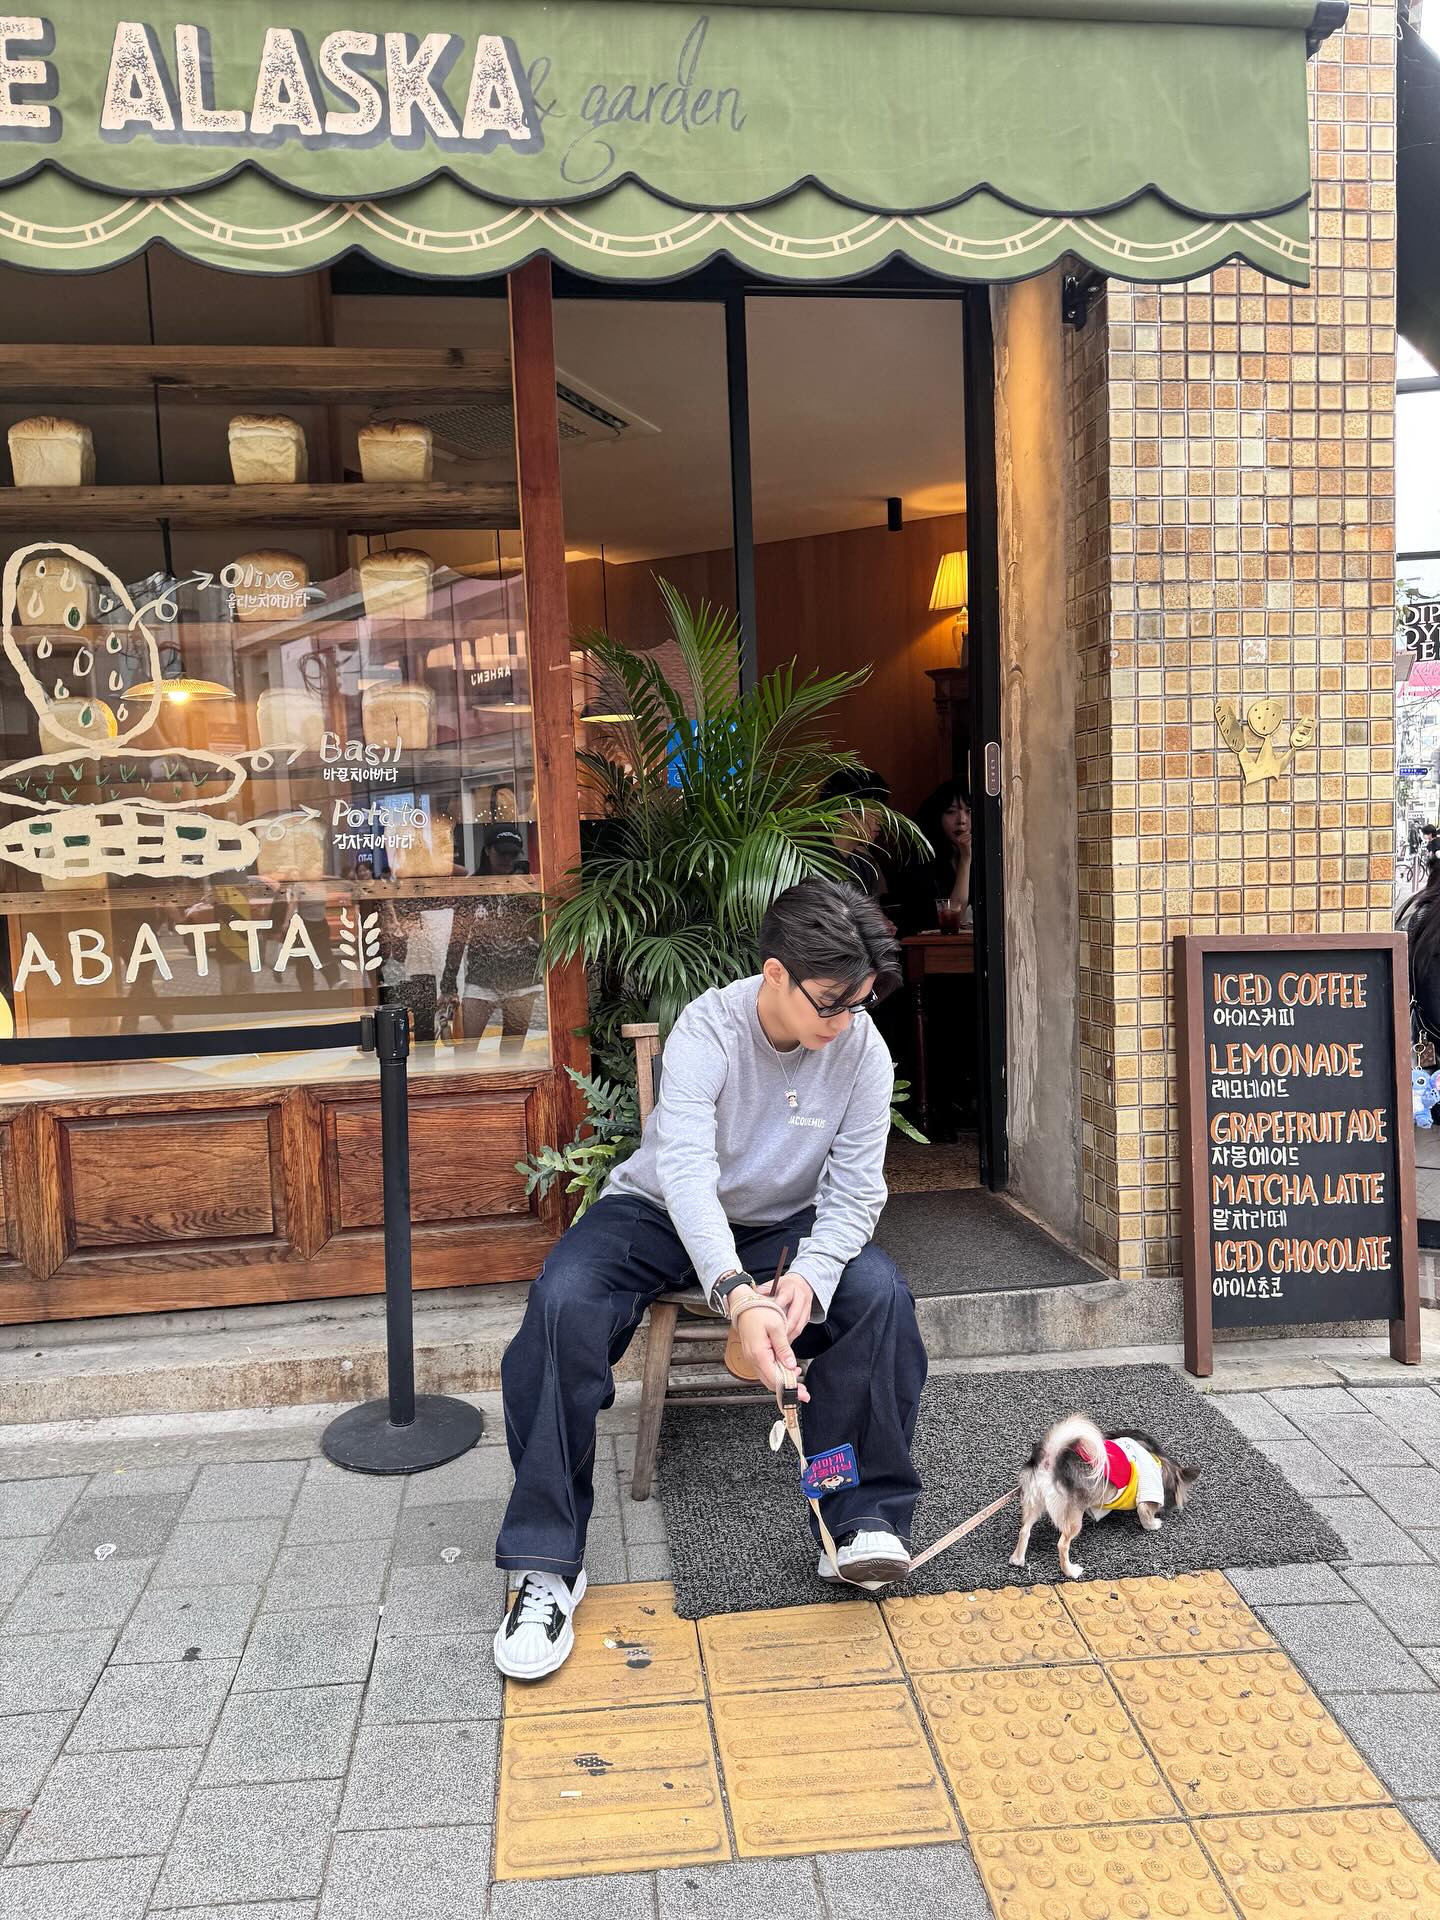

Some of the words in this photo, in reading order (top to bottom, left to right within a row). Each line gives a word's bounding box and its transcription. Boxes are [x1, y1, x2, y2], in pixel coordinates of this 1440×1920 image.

[101, 21, 534, 142] ALASKA
[560, 15, 748, 184] garden
[220, 563, 299, 590] Olive
[320, 731, 402, 766] Basil
[332, 799, 428, 828] Potato
[14, 912, 323, 992] ABATTA
[1213, 973, 1272, 1005] ICED
[1278, 972, 1367, 1009] COFFEE
[1213, 1007, 1295, 1027] 아이스커피
[1210, 1042, 1364, 1077] LEMONADE
[1211, 1078, 1290, 1099] 레모네이드
[1210, 1110, 1346, 1144] GRAPEFRUIT
[1346, 1108, 1388, 1143] ADE
[1211, 1146, 1300, 1168] 자몽에이드
[1212, 1173, 1319, 1206] MATCHA
[1323, 1172, 1385, 1204] LATTE
[1212, 1208, 1288, 1231] 말차라떼
[1214, 1239, 1264, 1273] ICED
[1267, 1236, 1392, 1274] CHOCOLATE
[1212, 1276, 1284, 1298] 아이스초코
